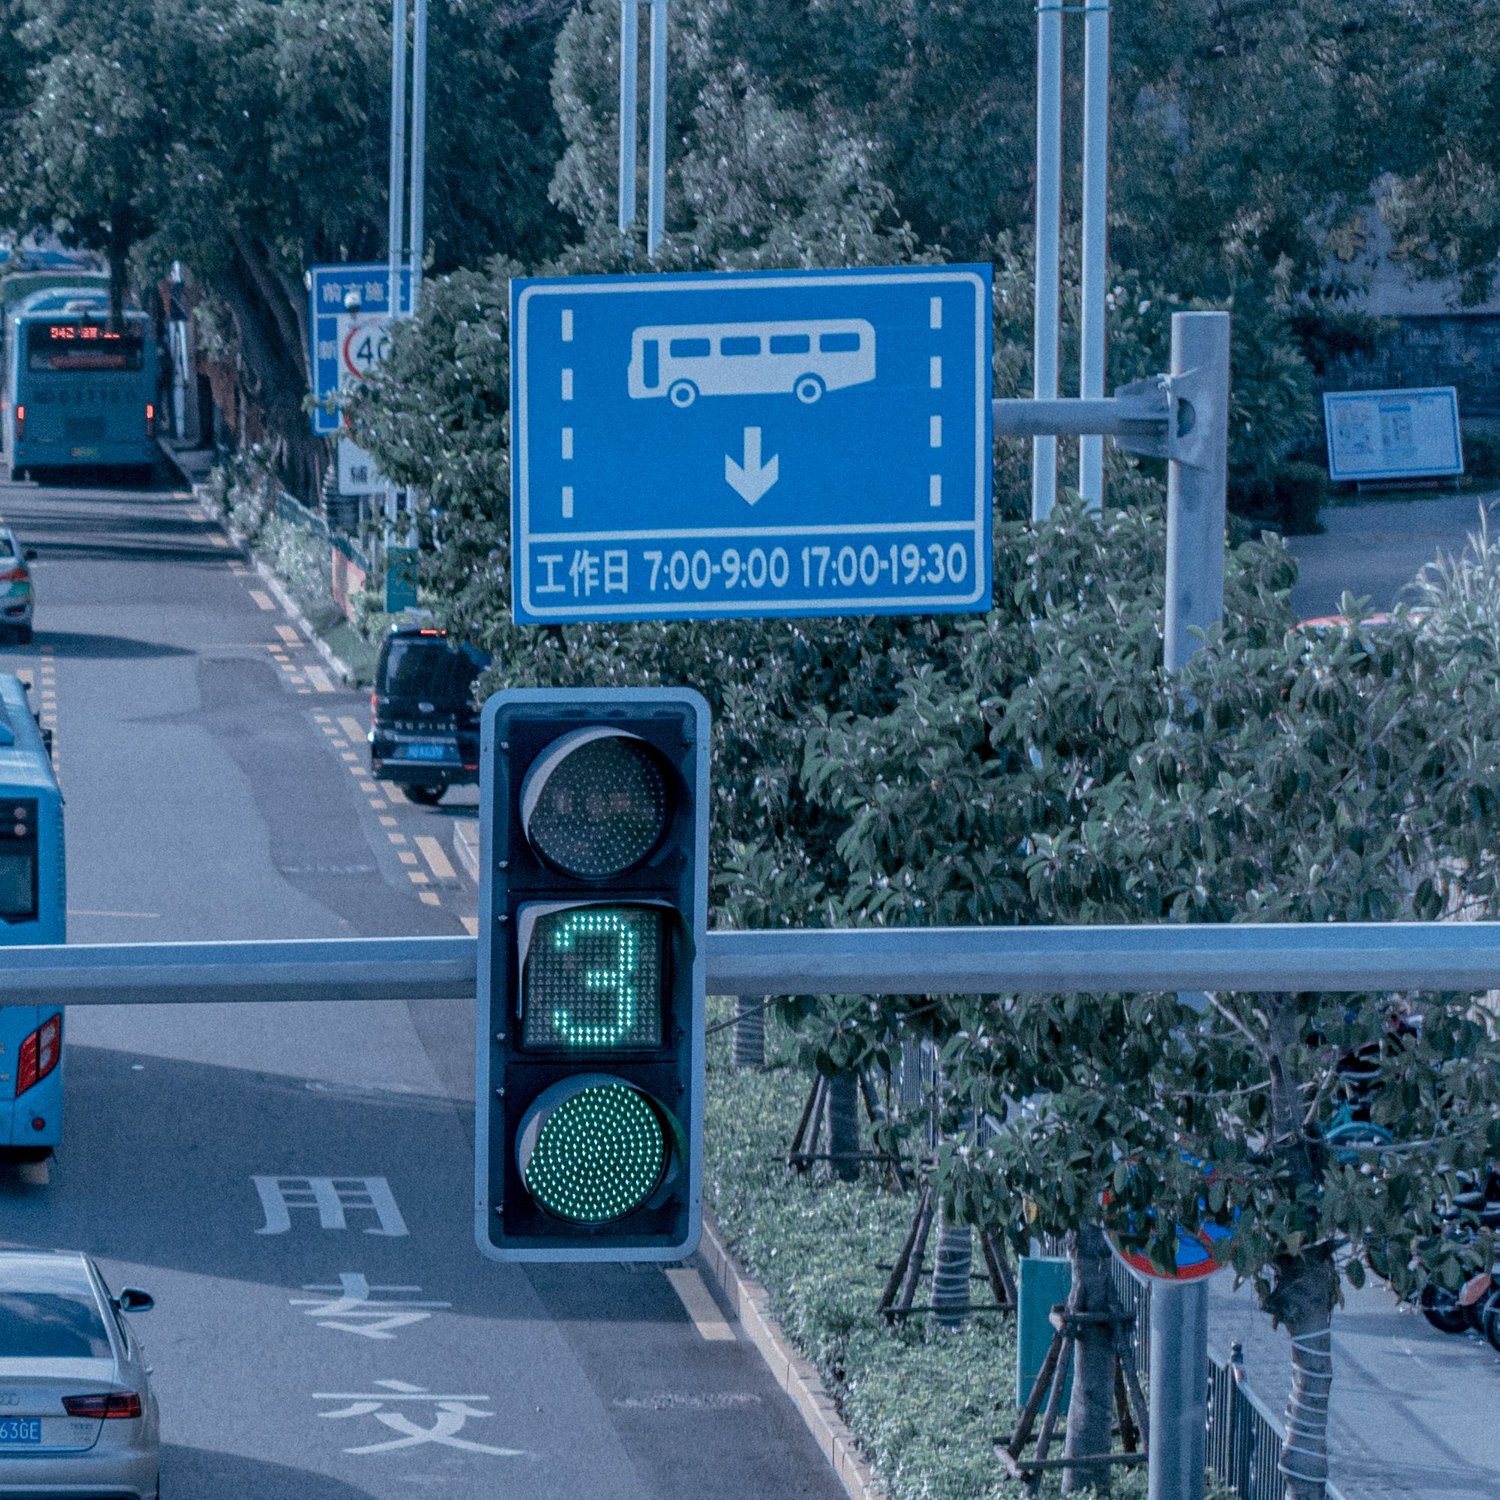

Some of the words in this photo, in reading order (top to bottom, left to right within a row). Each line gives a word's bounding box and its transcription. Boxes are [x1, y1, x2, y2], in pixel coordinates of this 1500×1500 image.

[535, 549, 628, 596] 工作日
[642, 547, 790, 592] 7:00-9:00
[801, 542, 968, 588] 17:00-19:30
[554, 914, 635, 1044] 3
